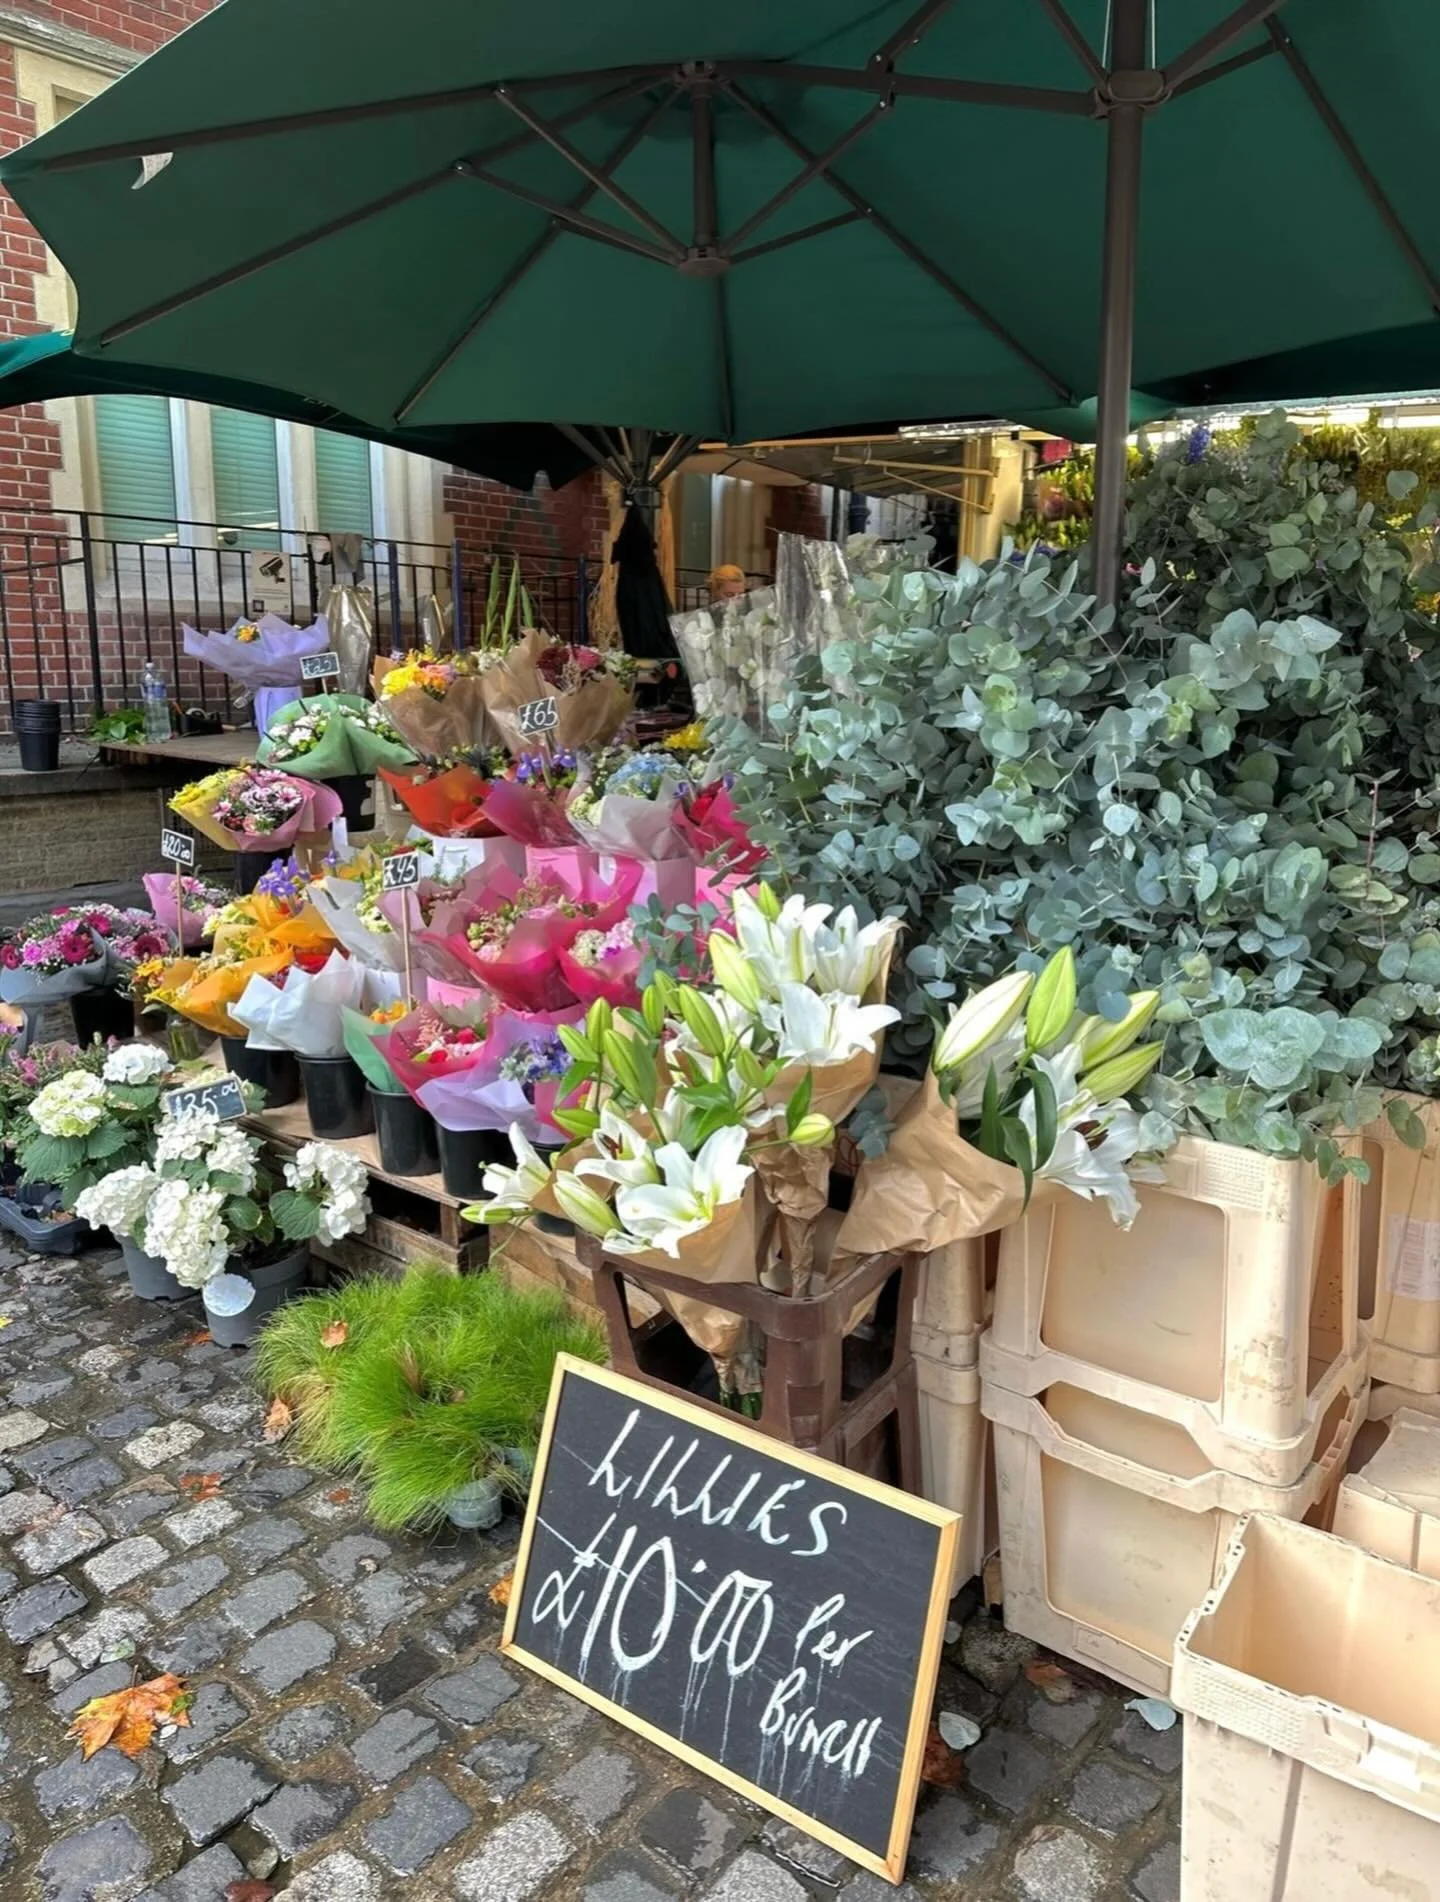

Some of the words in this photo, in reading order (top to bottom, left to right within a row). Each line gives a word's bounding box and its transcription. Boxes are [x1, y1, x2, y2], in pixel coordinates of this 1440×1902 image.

[521, 698, 558, 730] £65
[384, 854, 416, 885] £45
[589, 1409, 847, 1556] LILLIES
[795, 1593, 873, 1667] Per
